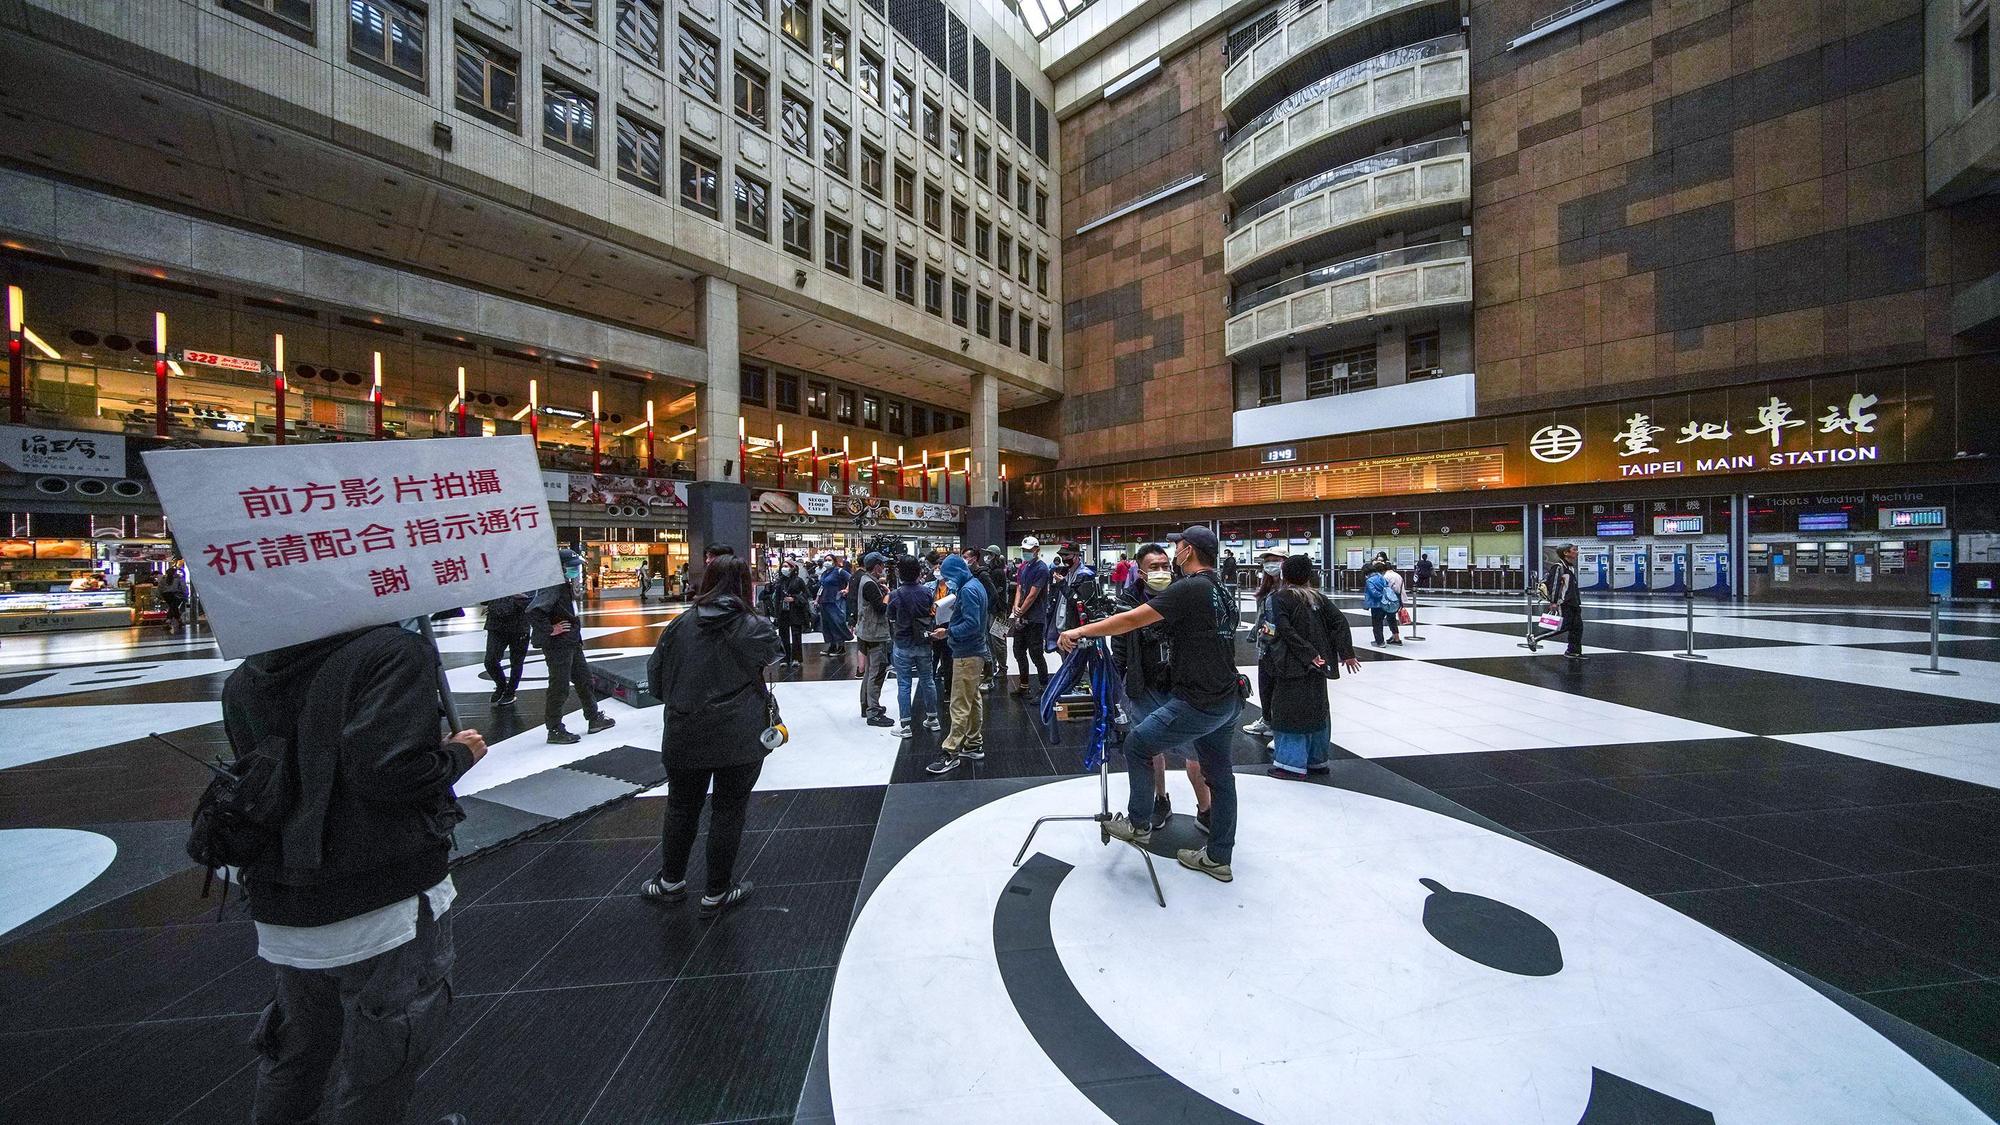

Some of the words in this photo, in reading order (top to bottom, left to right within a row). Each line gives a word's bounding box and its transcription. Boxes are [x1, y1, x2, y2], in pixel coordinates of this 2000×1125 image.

[187, 352, 219, 365] 328
[1613, 393, 1878, 457] 臺北車站
[1406, 454, 1435, 462] Eastbound
[1435, 452, 1463, 460] Departure
[1619, 461, 1682, 476] TAIPEI
[1696, 455, 1753, 471] MAIN
[1769, 446, 1877, 466] STATION
[239, 469, 502, 519] 前方影片拍攝
[1766, 497, 1809, 506] Tickets
[1816, 494, 1864, 505] Vending
[1872, 491, 1924, 502] Machine
[1564, 500, 1700, 515] 自動售票機
[203, 505, 540, 576] 祈請配合指示通行
